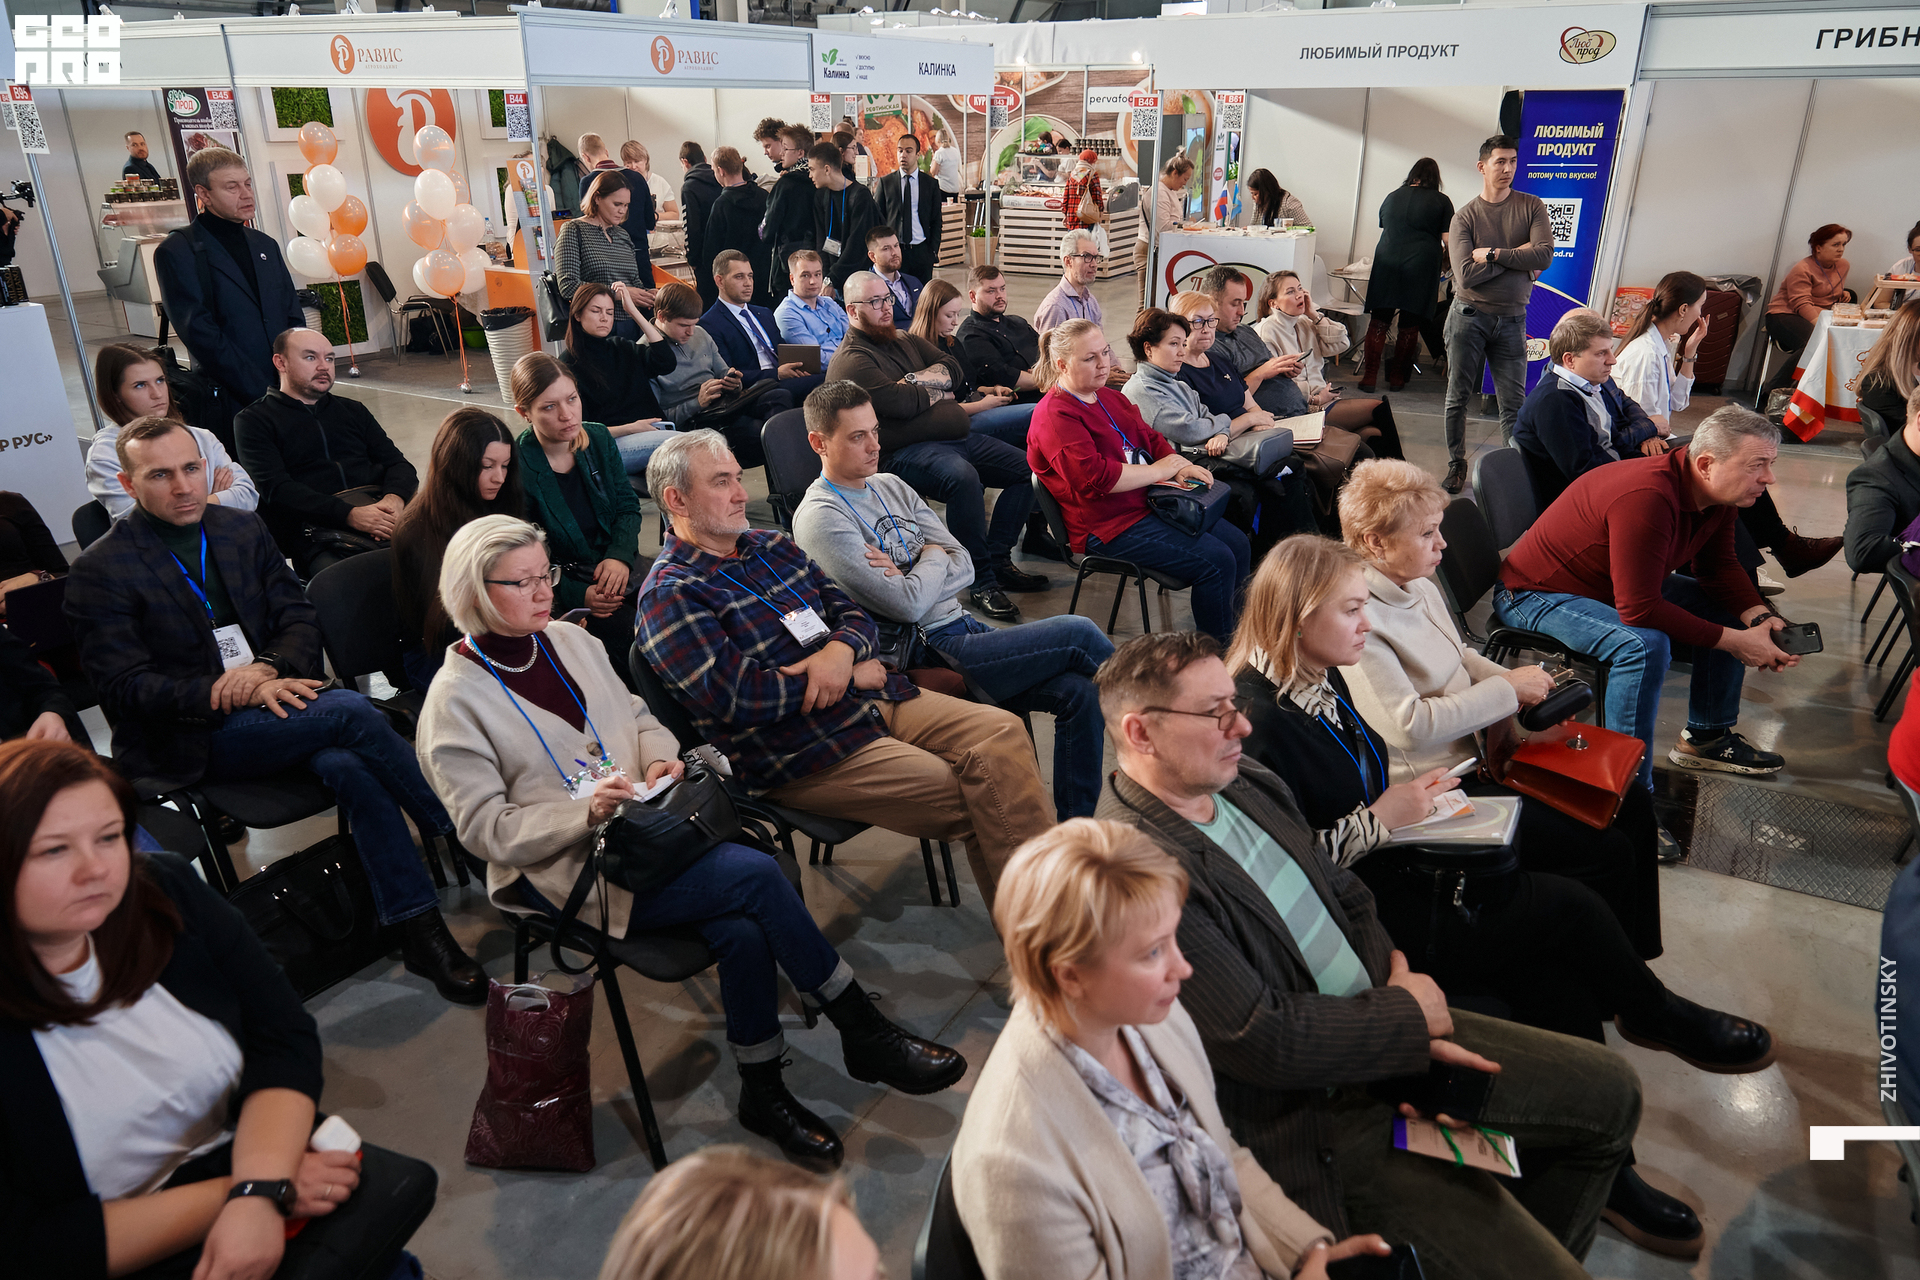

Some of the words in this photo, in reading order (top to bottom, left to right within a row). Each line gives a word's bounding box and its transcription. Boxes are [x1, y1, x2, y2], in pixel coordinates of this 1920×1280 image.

[357, 47, 403, 63] РАВИС
[677, 49, 719, 66] РАВИС
[1300, 43, 1382, 60] ЛЮБИМЫЙ
[1386, 44, 1459, 60] ПРОДУКТ
[1576, 47, 1601, 60] прод
[823, 67, 850, 79] Калинка
[918, 62, 957, 77] КАЛИНКА
[175, 100, 194, 111] ПРОД
[1089, 93, 1133, 104] pervafoo
[865, 103, 900, 113] РЕФТИНСКАЯ
[1533, 122, 1605, 139] ЛЮБИМЫЙ
[1536, 143, 1597, 158] ПРОДУКТ
[1527, 172, 1554, 180] потому
[1569, 171, 1597, 180] вкусно!
[1552, 250, 1574, 258] od.ru
[12, 433, 53, 450] РУС»
